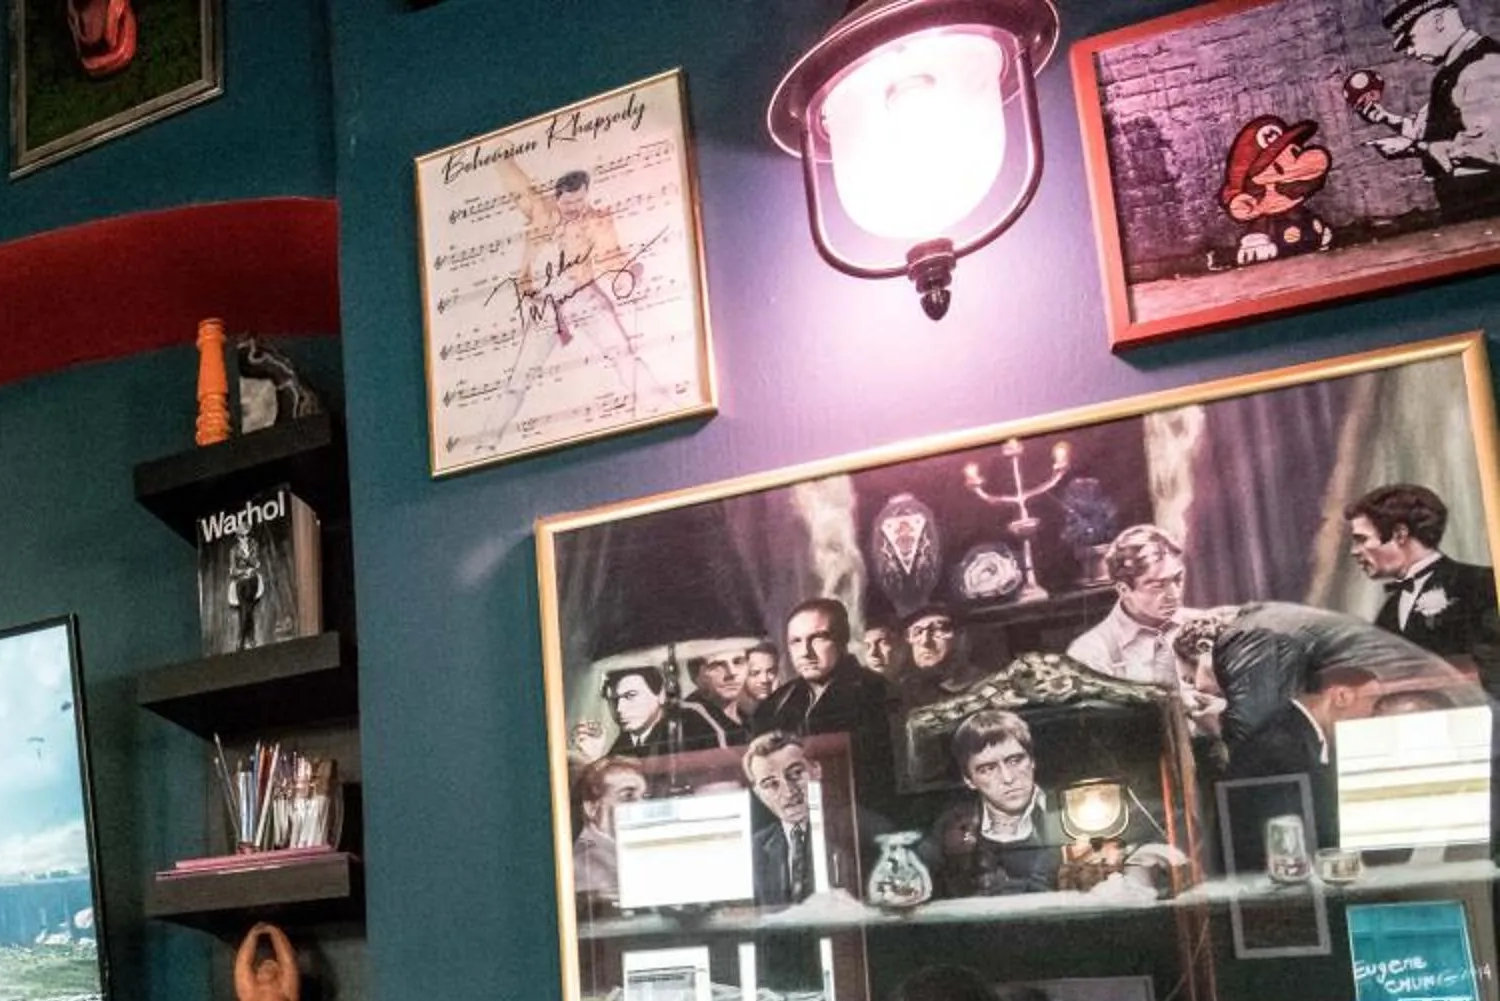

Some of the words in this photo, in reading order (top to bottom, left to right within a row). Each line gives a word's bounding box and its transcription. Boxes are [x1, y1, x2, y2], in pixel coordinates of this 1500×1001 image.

[441, 140, 538, 185] Bohemian
[545, 93, 646, 149] Rhapsody
[201, 491, 285, 543] Warhol
[1353, 955, 1427, 984] Eugene
